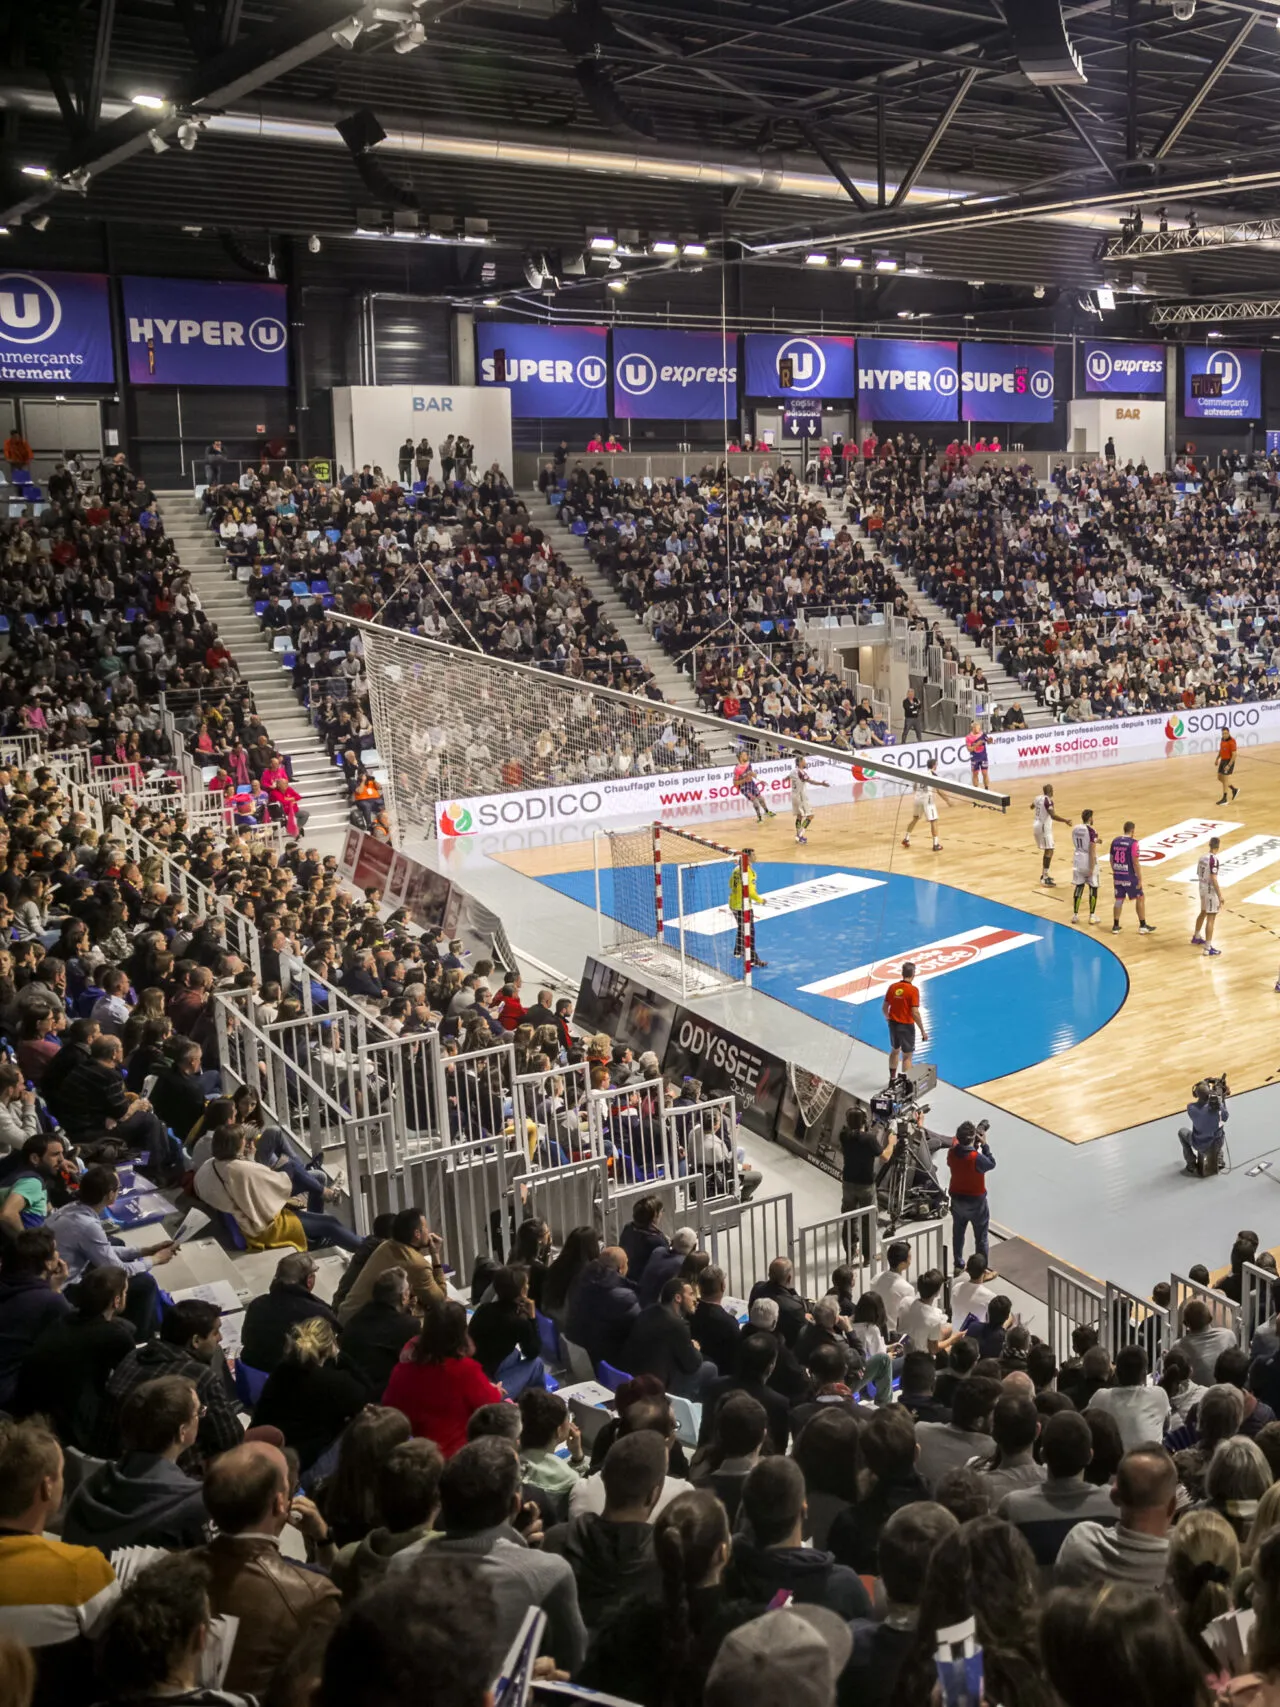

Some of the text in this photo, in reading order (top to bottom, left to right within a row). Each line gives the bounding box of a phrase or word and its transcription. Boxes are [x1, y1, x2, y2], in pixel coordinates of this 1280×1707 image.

[0, 292, 40, 328] U
[129, 317, 245, 346] HYPER
[0, 366, 71, 379] trement
[481, 358, 573, 382] SUPER
[660, 365, 737, 387] express
[1114, 360, 1162, 375] express
[858, 369, 931, 391] HYPER
[962, 372, 1014, 393] SUPE
[413, 397, 453, 411] BAR
[1116, 409, 1140, 420] BAR
[1017, 733, 1033, 741] bois
[1035, 731, 1051, 740] pour
[1054, 729, 1065, 737] les
[1066, 723, 1119, 737] professionnels
[1121, 720, 1144, 731] depuis
[1188, 709, 1259, 733] SODICO
[1018, 735, 1119, 757] www.sodico.eu
[604, 781, 655, 794] Chauffage
[658, 777, 679, 788] bois
[682, 774, 704, 787] pour
[707, 772, 721, 782] les
[479, 791, 601, 826] SODICO
[1157, 823, 1222, 848] VEOLIA
[1114, 851, 1126, 864] 48
[680, 1020, 762, 1088] ODYSSEE
